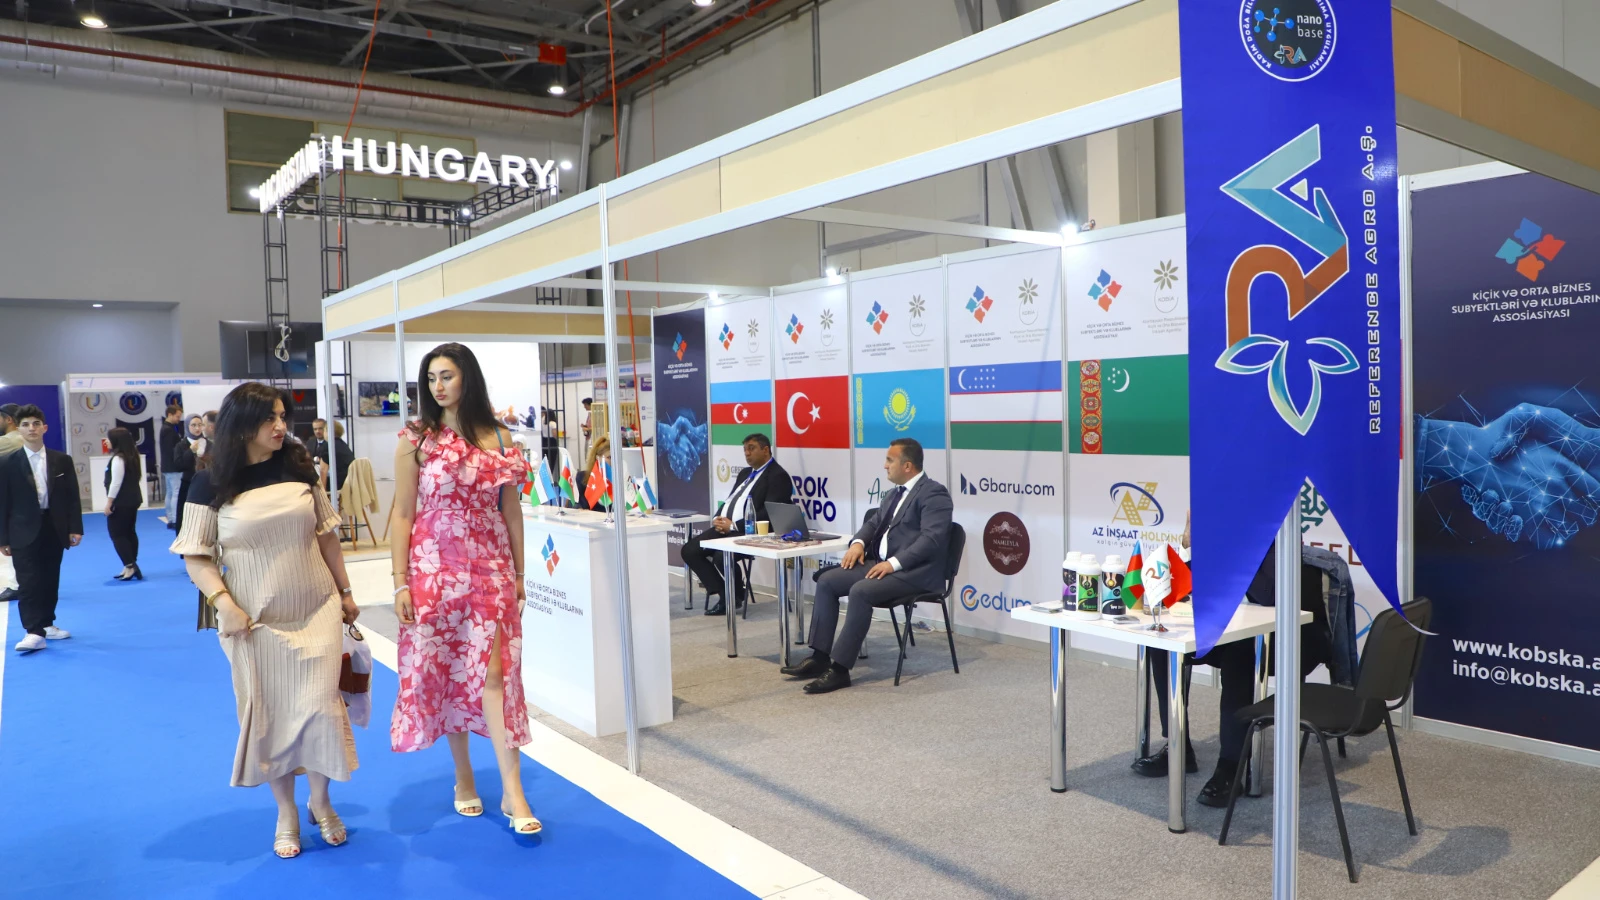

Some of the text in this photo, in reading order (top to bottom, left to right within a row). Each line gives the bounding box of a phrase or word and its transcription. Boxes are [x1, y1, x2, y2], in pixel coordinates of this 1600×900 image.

[1296, 14, 1323, 25] nano
[1297, 25, 1323, 38] base
[331, 135, 555, 189] HUNGARY
[1363, 189, 1378, 264] AGRO
[1472, 282, 1592, 302] KİÇİK VƏ ORTA BİZNES
[1451, 298, 1520, 314] SUBYEKTLƏRİ
[1365, 272, 1381, 433] REFERENCE
[979, 477, 1055, 496] Gbaru.com
[793, 499, 837, 522] XPO
[1092, 526, 1104, 536] AZ
